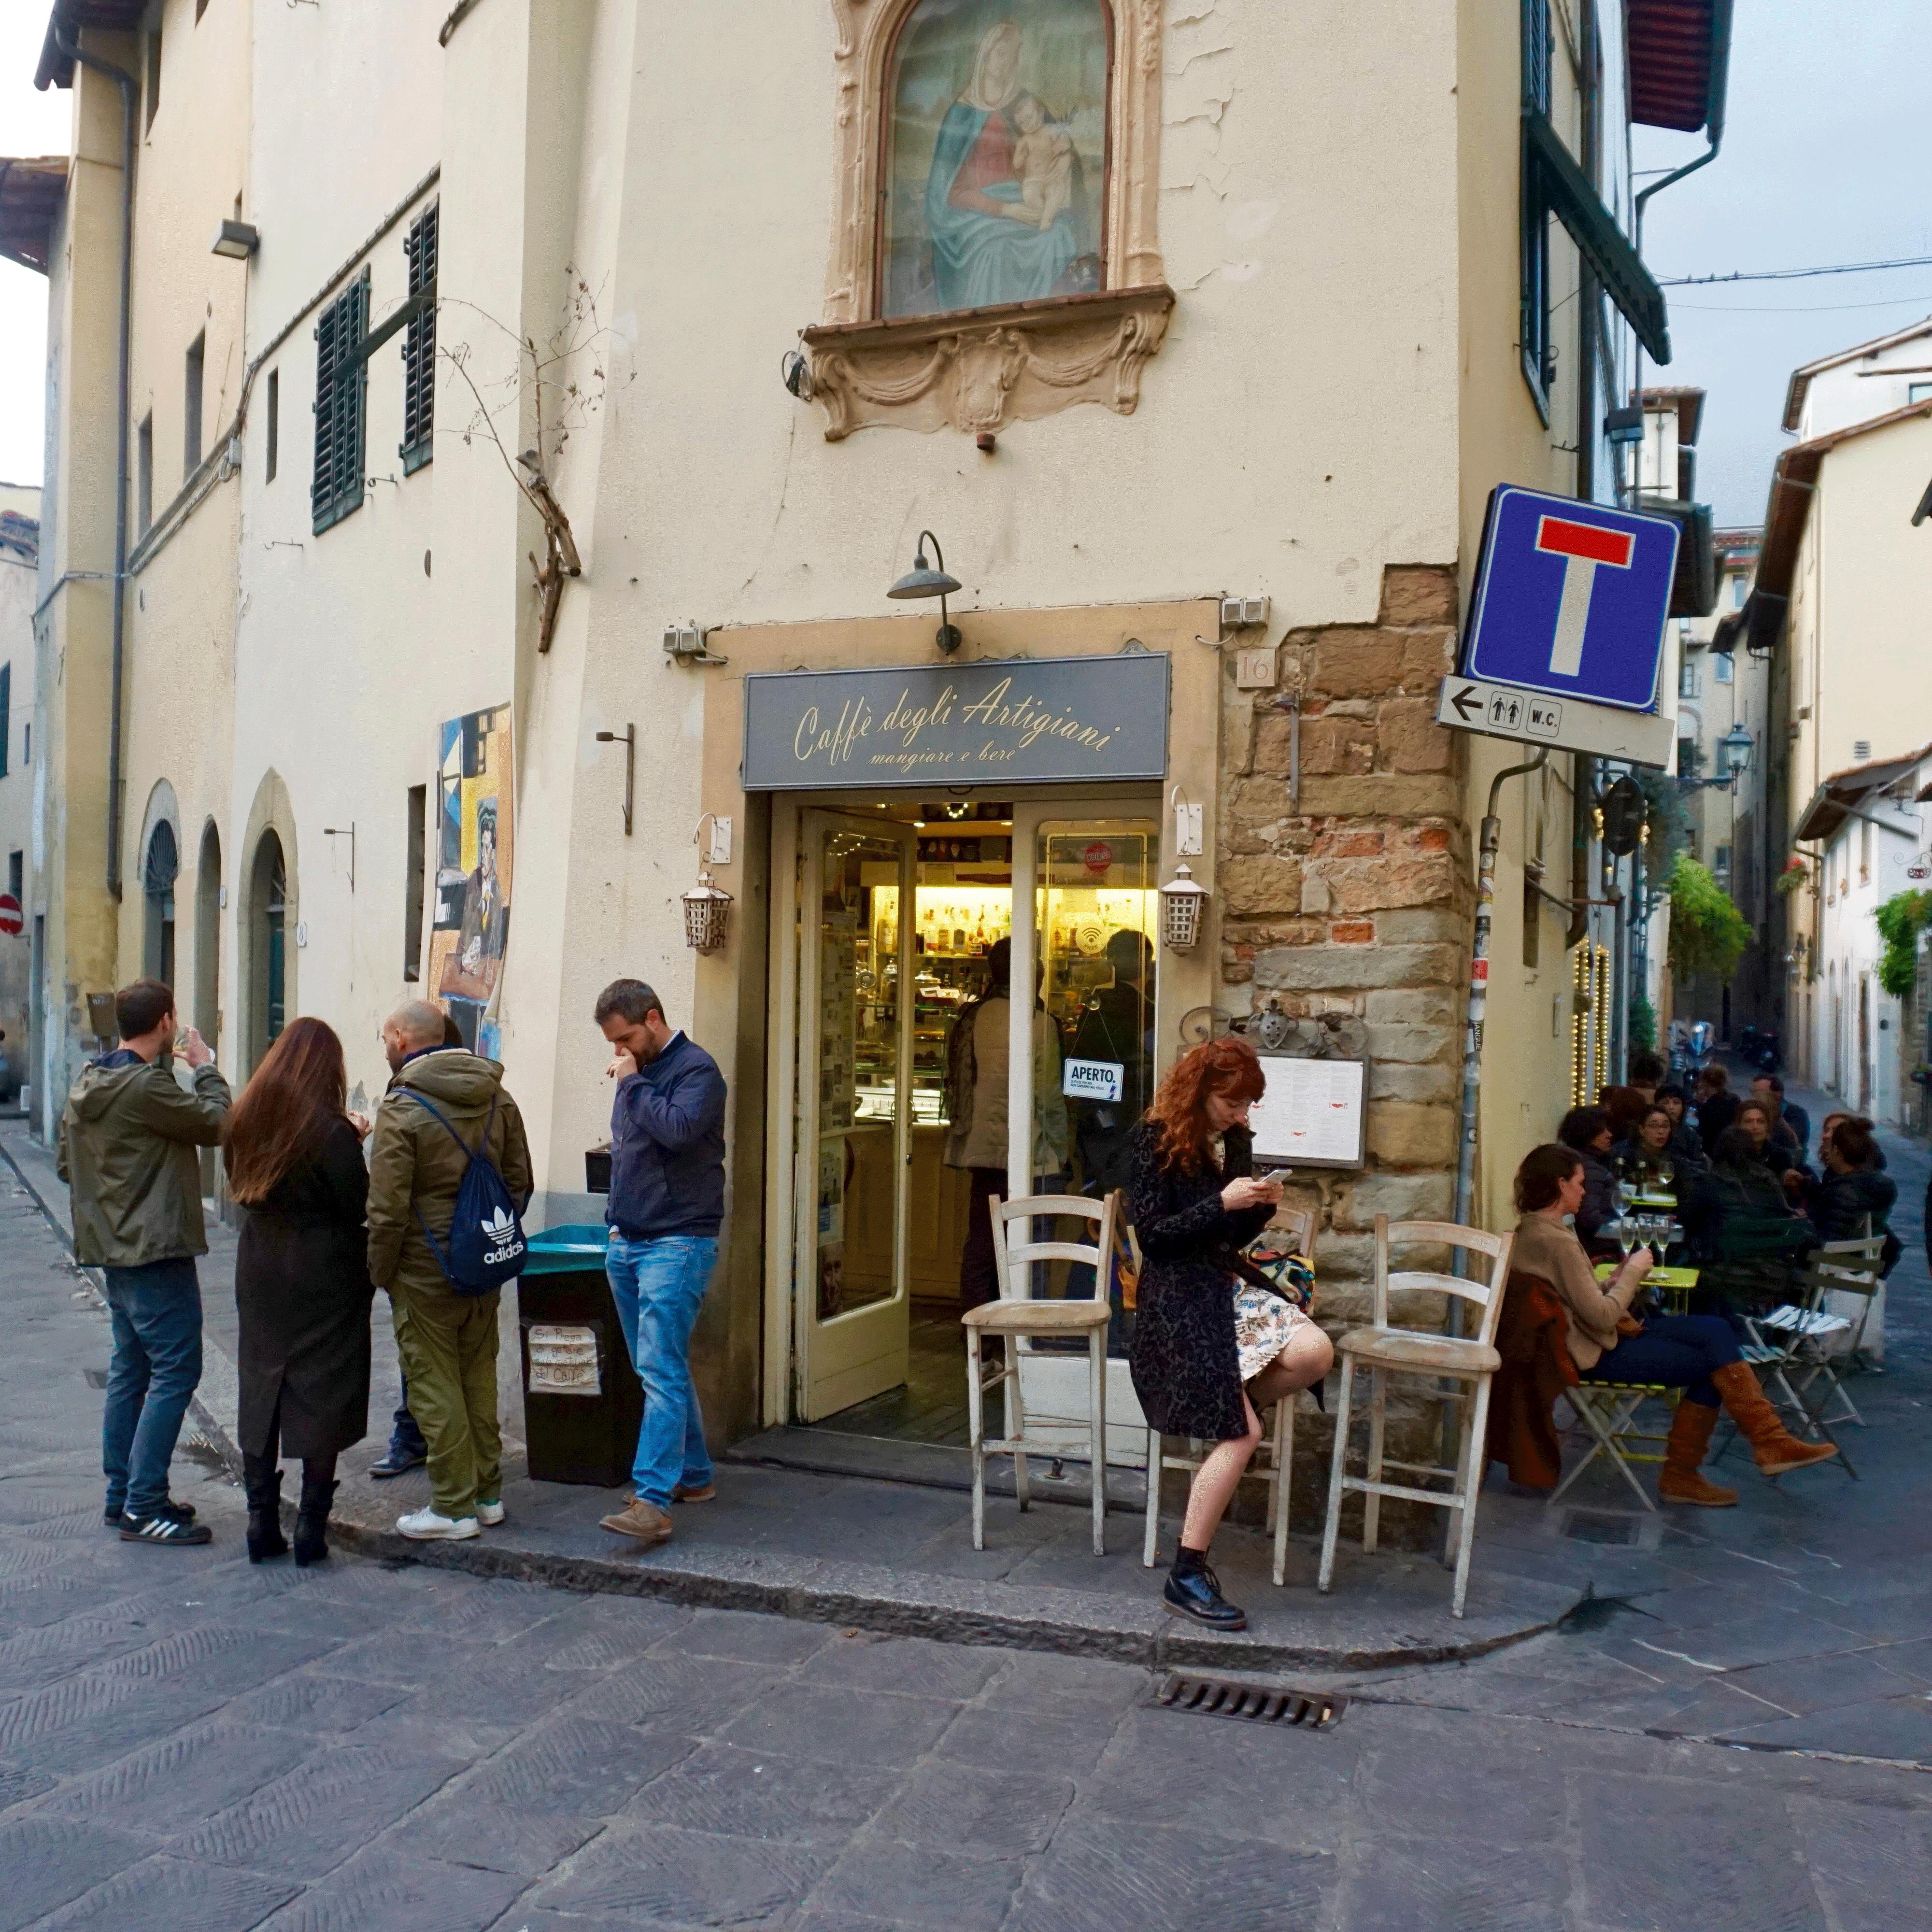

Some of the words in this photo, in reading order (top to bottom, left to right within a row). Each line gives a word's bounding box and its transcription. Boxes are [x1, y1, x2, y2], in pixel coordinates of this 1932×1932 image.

[1244, 656, 1269, 680] 16
[795, 696, 872, 766] Caffè
[876, 684, 958, 748] degli
[963, 677, 1121, 752] Artigiani
[1532, 709, 1557, 727] W.C.
[865, 747, 954, 773] mangiare
[956, 751, 970, 762] e
[973, 740, 1016, 762] bere
[299, 924, 304, 942] 8
[1071, 1066, 1116, 1083] APERTO.
[484, 1241, 524, 1264] adidas
